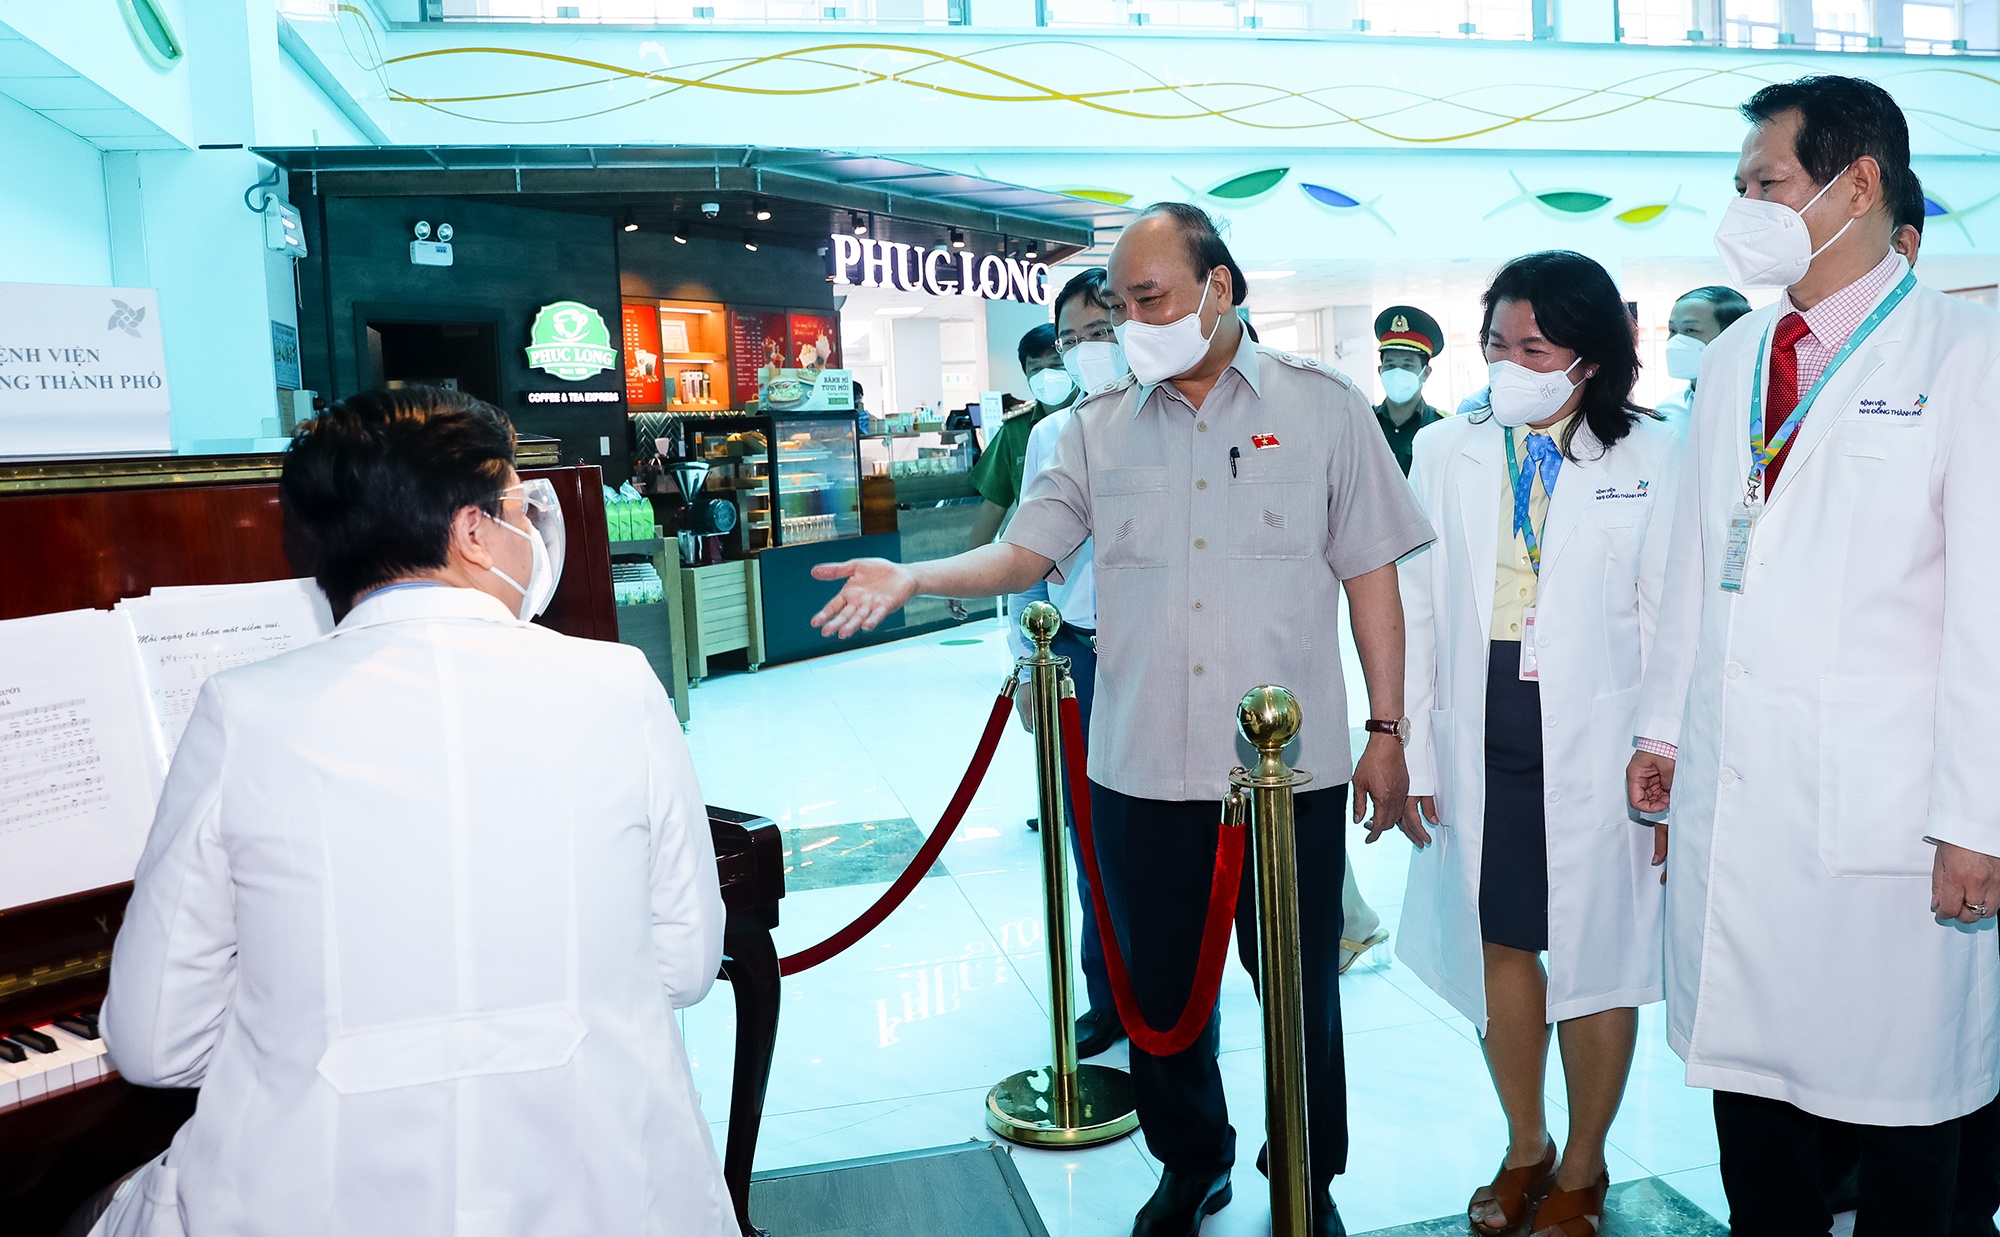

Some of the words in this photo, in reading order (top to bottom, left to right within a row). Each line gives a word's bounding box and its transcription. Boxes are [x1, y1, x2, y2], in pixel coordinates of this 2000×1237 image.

[830, 233, 958, 297] PHUC
[959, 251, 1053, 306] LONG
[48, 346, 100, 367] VIỆN
[530, 348, 571, 365] PHUC
[574, 348, 613, 366] LONG
[36, 371, 114, 390] THÀNH
[528, 392, 560, 403] COFFEE
[561, 393, 568, 402] &
[568, 392, 584, 402] TEA
[585, 392, 619, 402] EXPRESS
